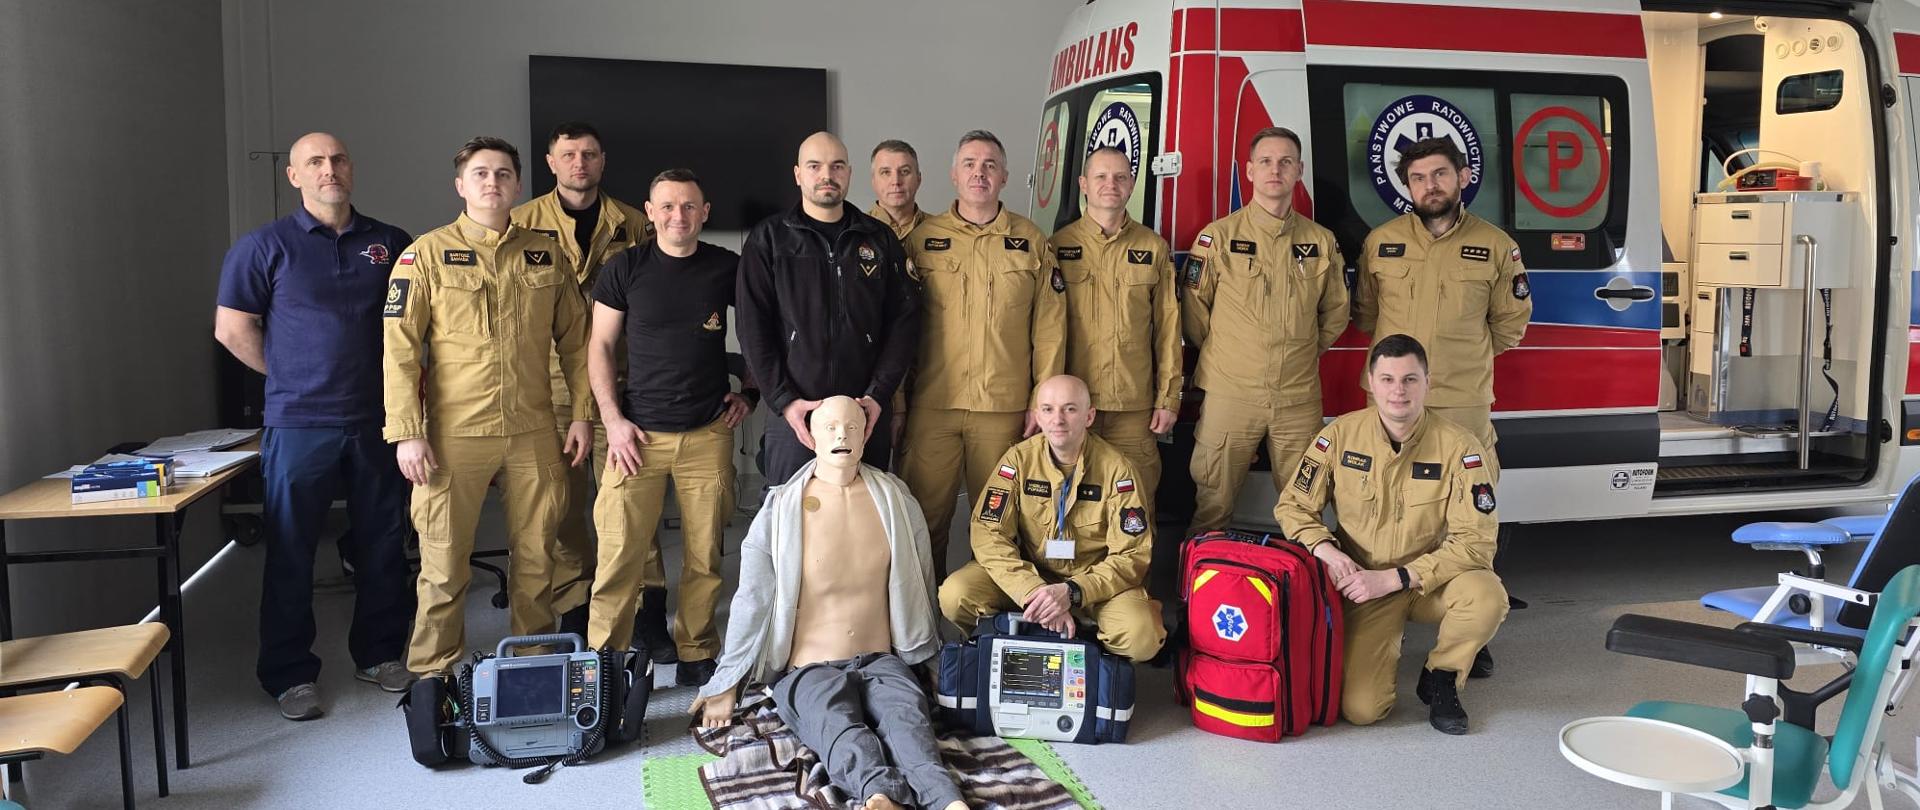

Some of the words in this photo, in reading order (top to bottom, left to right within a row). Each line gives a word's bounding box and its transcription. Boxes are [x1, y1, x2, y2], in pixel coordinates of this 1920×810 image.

[1049, 21, 1138, 96] AMBULANS
[1089, 108, 1112, 148] TWOWE
[1118, 106, 1140, 178] RATOWNICTW
[1370, 101, 1415, 185] PAŃSTWOWE
[1431, 101, 1481, 185] RATOWNICTWO
[1547, 131, 1584, 193] P
